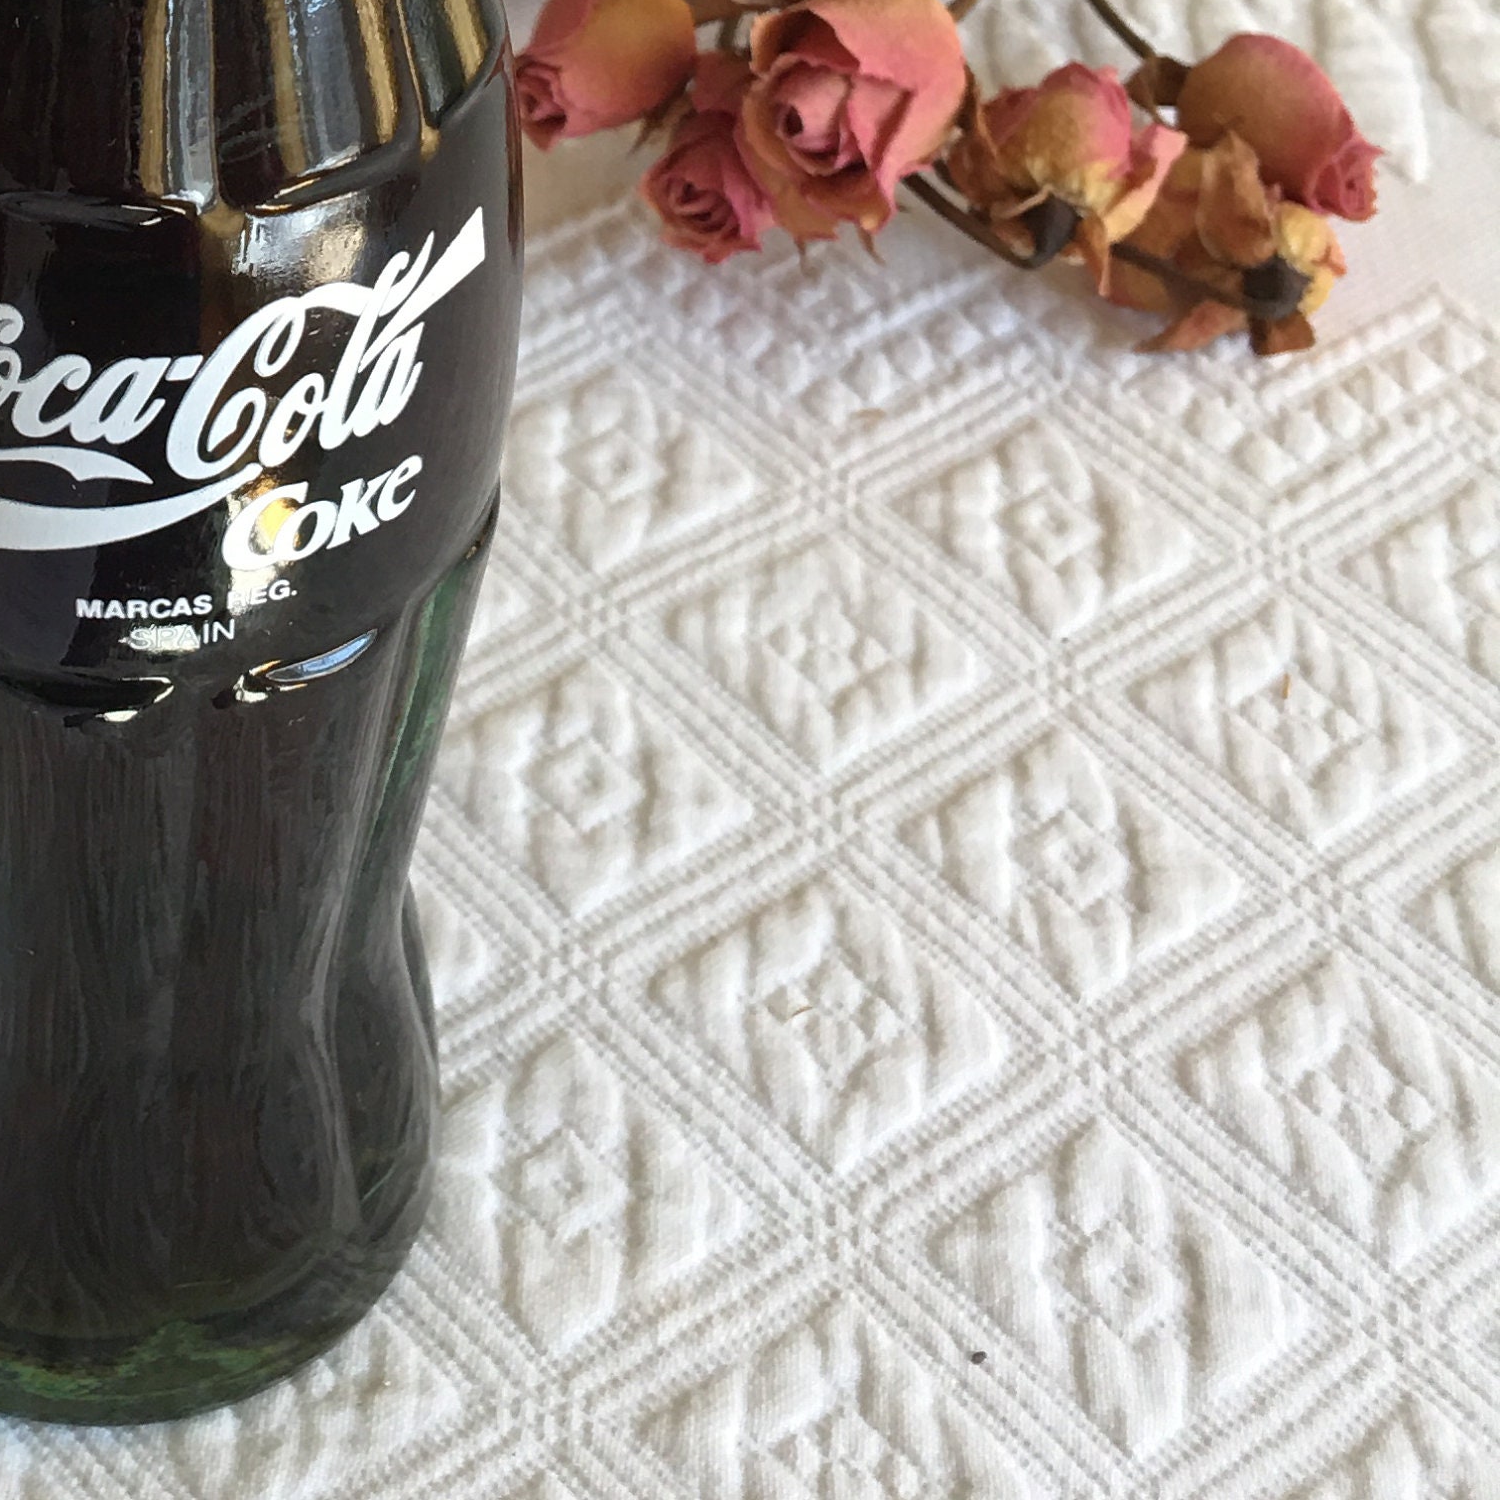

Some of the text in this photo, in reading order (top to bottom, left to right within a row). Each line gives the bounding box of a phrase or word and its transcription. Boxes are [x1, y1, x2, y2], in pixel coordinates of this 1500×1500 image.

[221, 455, 423, 571] Coke
[76, 594, 213, 619] MARCAS
[128, 618, 236, 650] SPAIN
